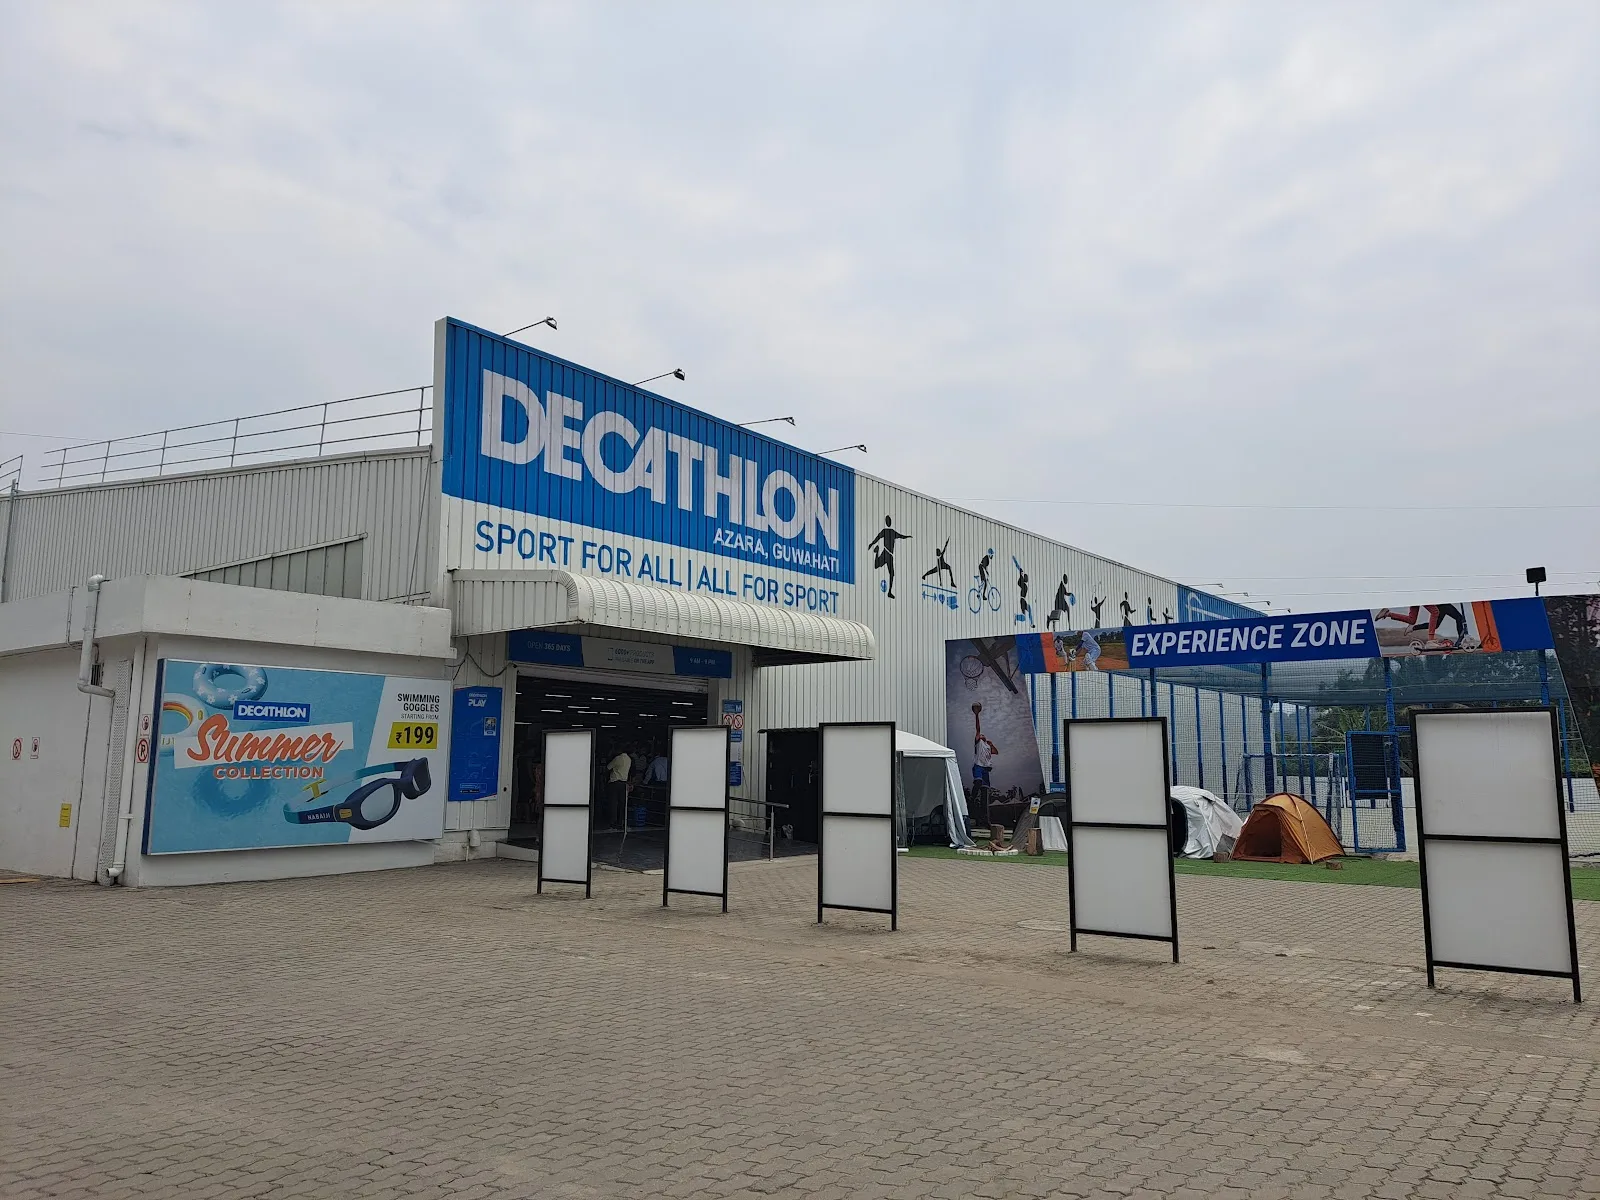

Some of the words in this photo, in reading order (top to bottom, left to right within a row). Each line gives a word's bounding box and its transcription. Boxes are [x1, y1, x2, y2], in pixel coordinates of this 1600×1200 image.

[481, 369, 840, 551] DECATHLON
[713, 528, 769, 559] AZARA,
[772, 542, 840, 573] GUWAHATI
[475, 520, 575, 566] SPORT
[582, 541, 632, 577] FOR
[637, 554, 683, 586] ALL
[696, 566, 737, 596] ALL
[743, 574, 779, 603] FOR
[783, 584, 839, 614] SPORT
[1131, 624, 1287, 656] EXPERIENCE
[1291, 619, 1367, 648] ZONE
[527, 640, 543, 649] OPEN
[544, 642, 555, 650] 365
[555, 643, 571, 652] DAYS
[397, 693, 440, 703] SWIMMING
[468, 698, 487, 707] PLAY
[238, 704, 307, 718] DECATHLON
[403, 703, 440, 712] GOGGLES
[187, 713, 343, 763] Summer
[395, 726, 434, 744] ₹199
[213, 766, 324, 780] COLLECTION
